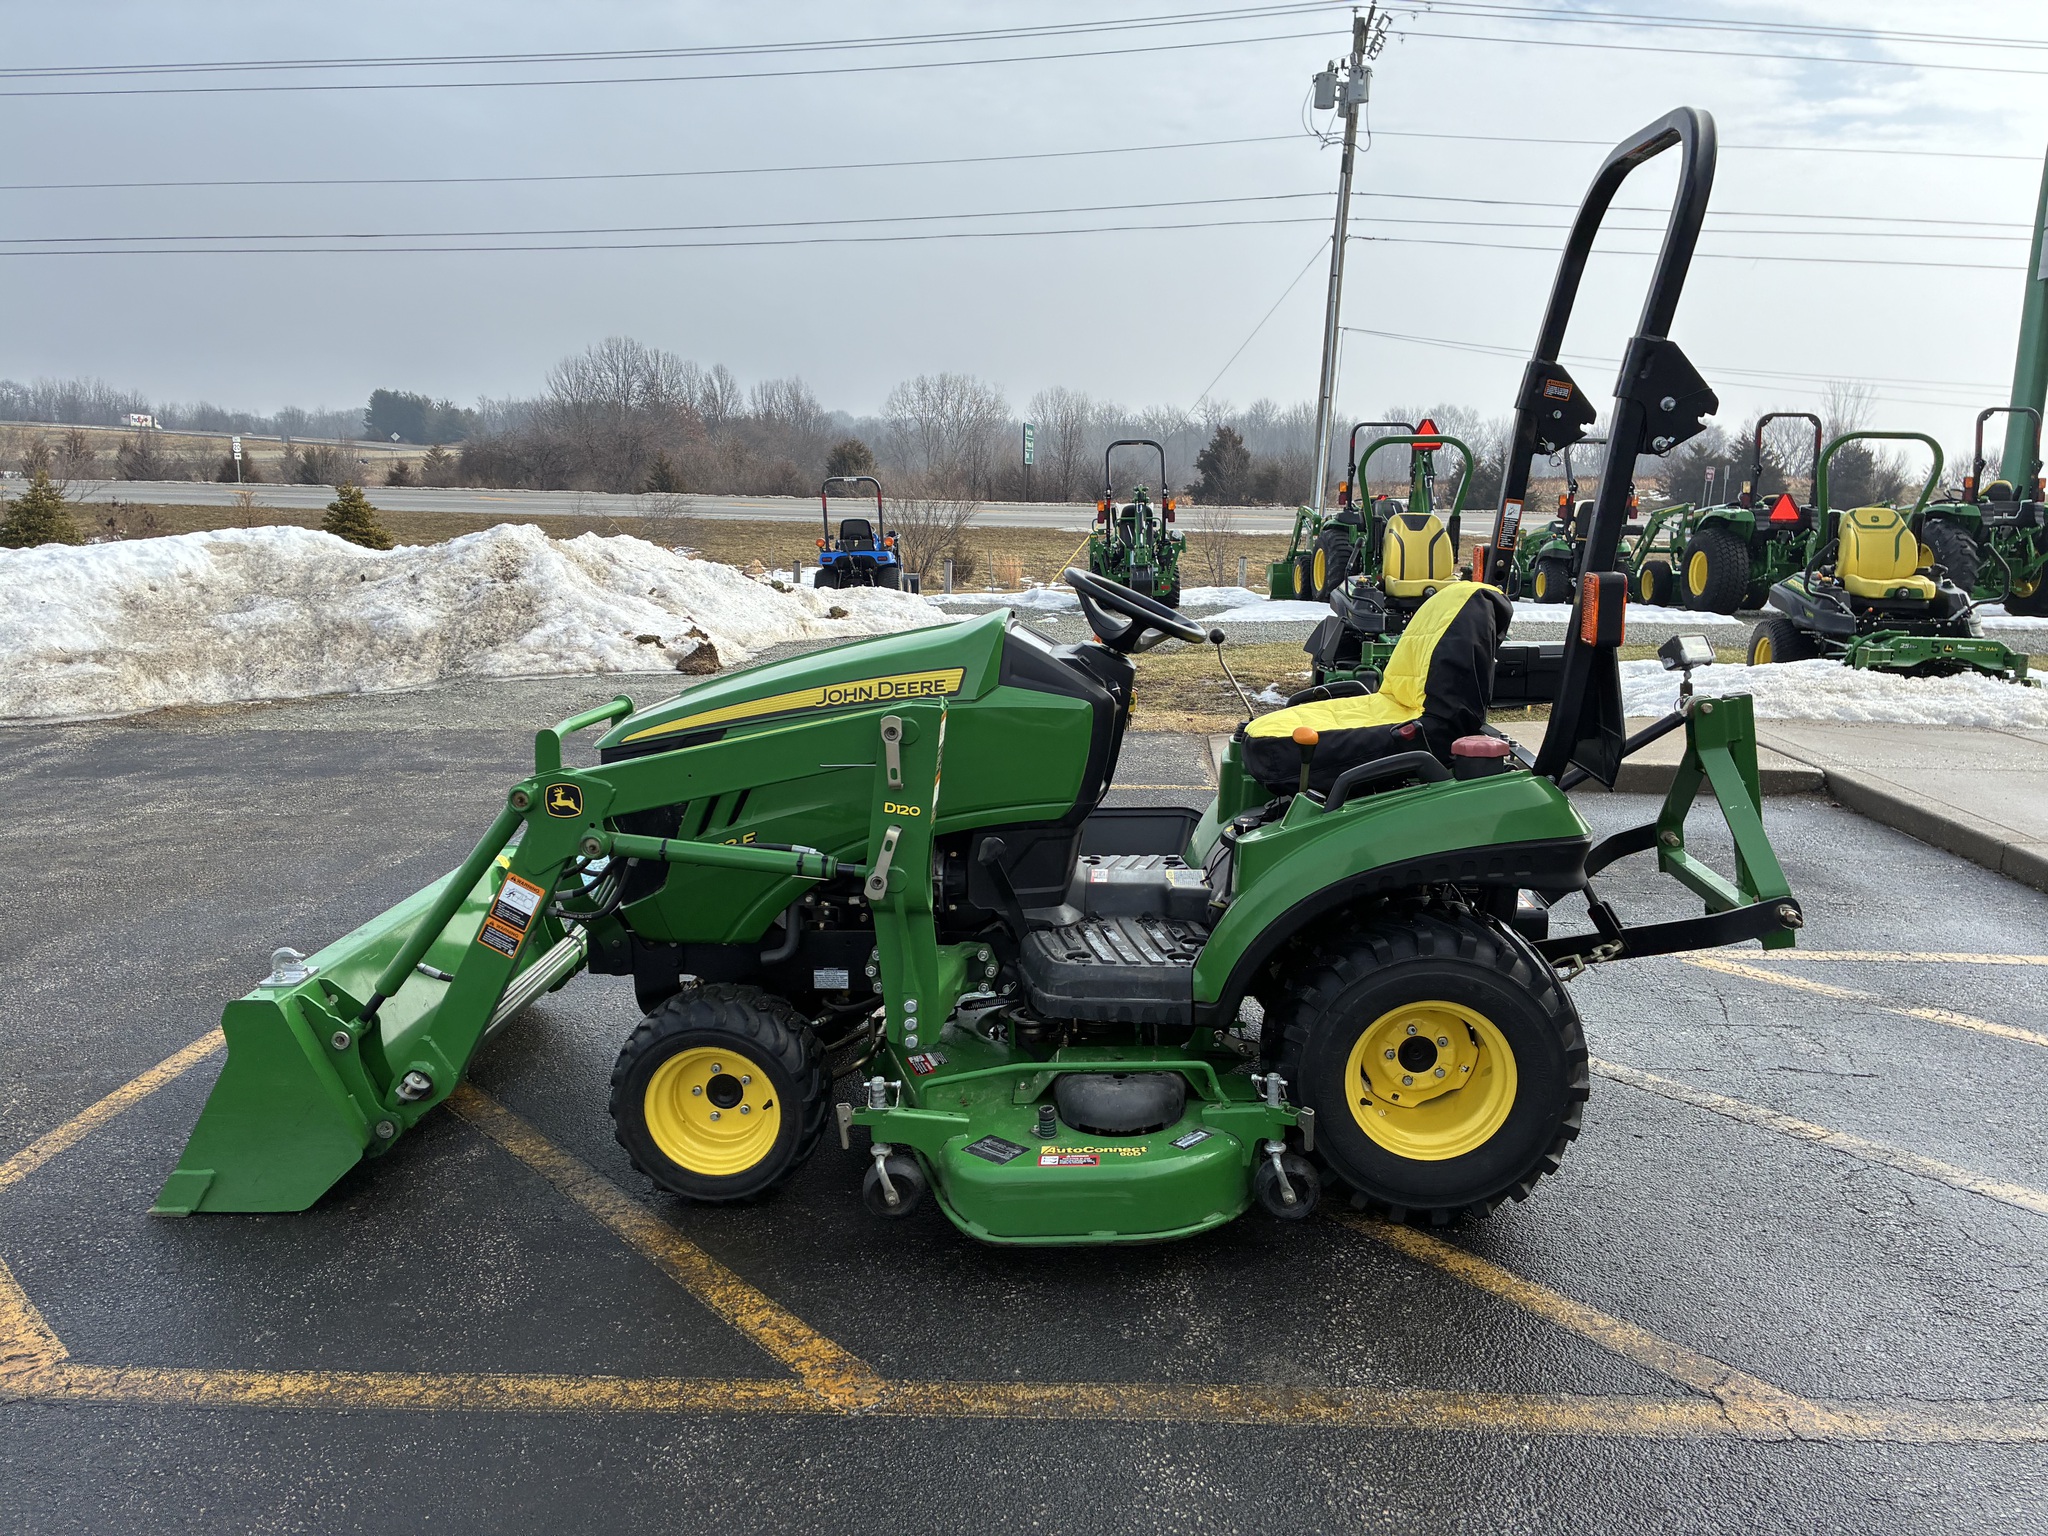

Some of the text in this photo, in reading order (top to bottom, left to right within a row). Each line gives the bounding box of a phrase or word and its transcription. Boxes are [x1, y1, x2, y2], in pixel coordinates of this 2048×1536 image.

[815, 679, 946, 705] JOHN DEERE
[884, 801, 921, 816] D120
[516, 878, 541, 895] WARNING
[496, 923, 520, 939] WARNING
[1040, 1145, 1149, 1155] AutoConnect
